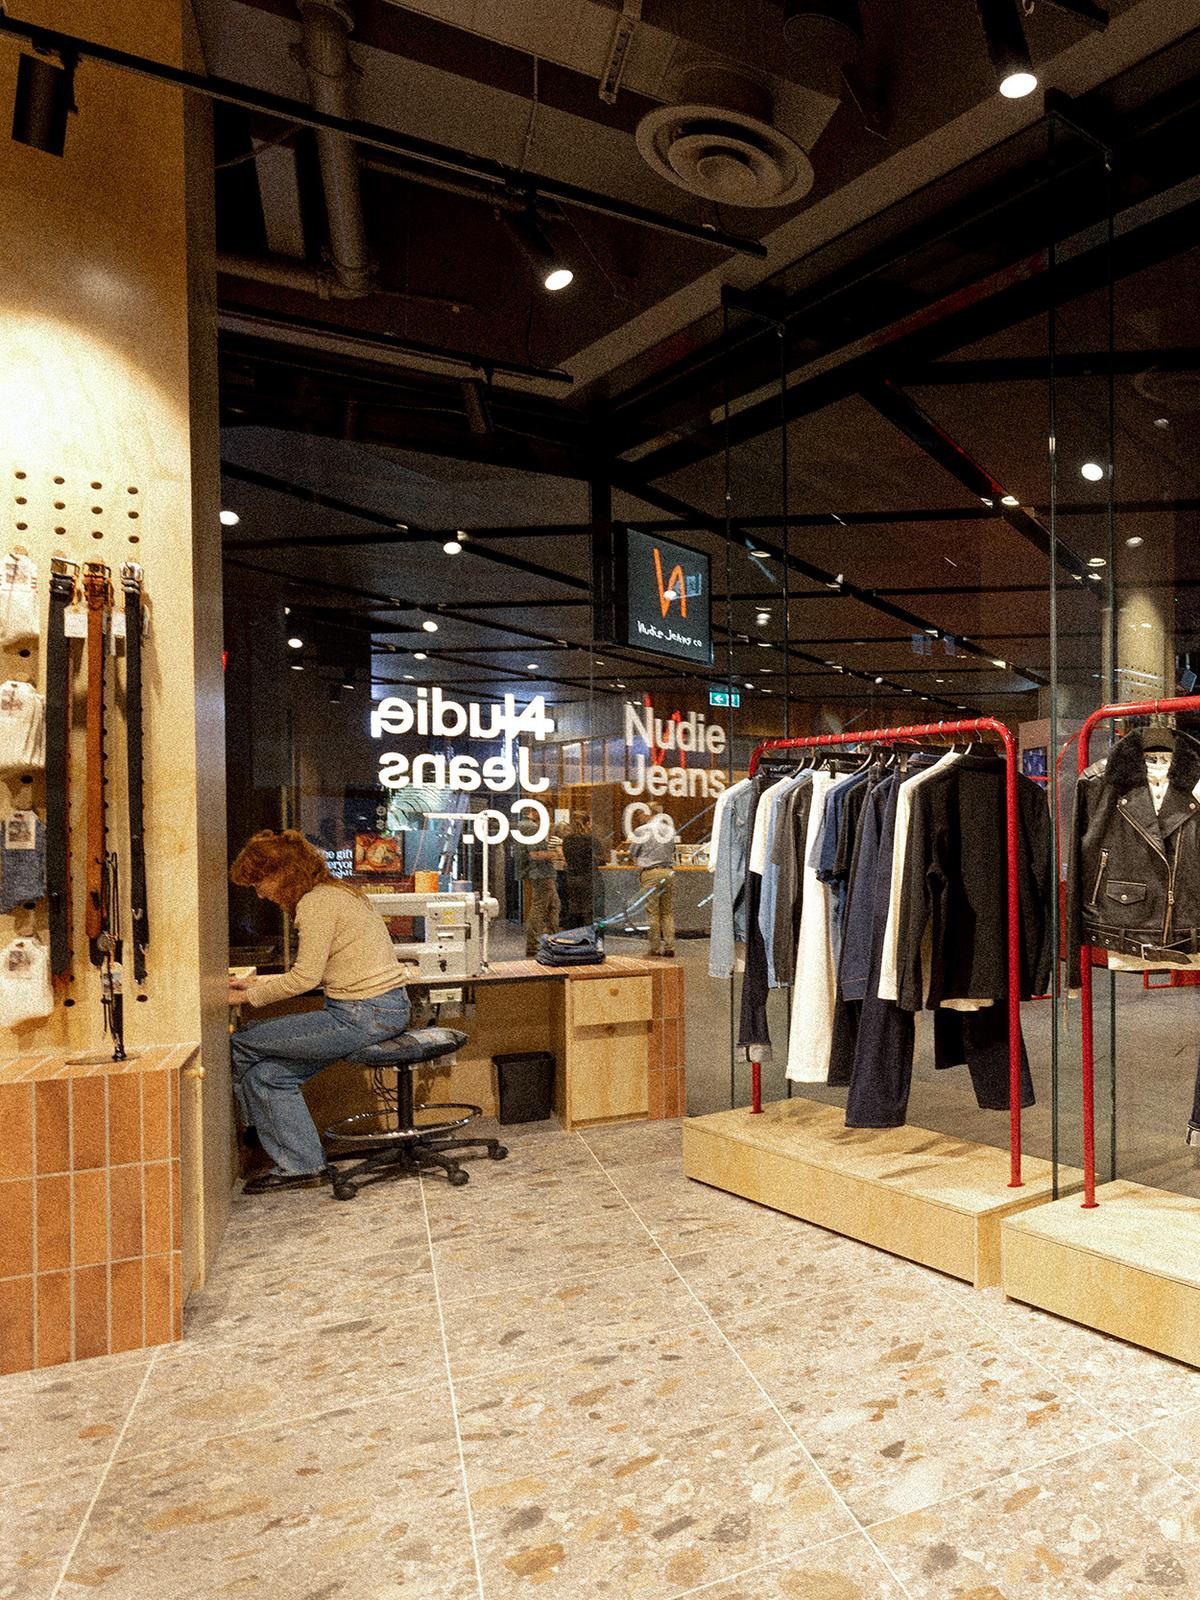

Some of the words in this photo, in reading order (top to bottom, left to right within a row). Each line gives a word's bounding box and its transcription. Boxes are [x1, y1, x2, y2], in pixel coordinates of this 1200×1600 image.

[637, 620, 663, 638] Nudie
[623, 703, 726, 754] Nudie
[622, 754, 727, 798] Jeans
[623, 801, 681, 844] Co.
